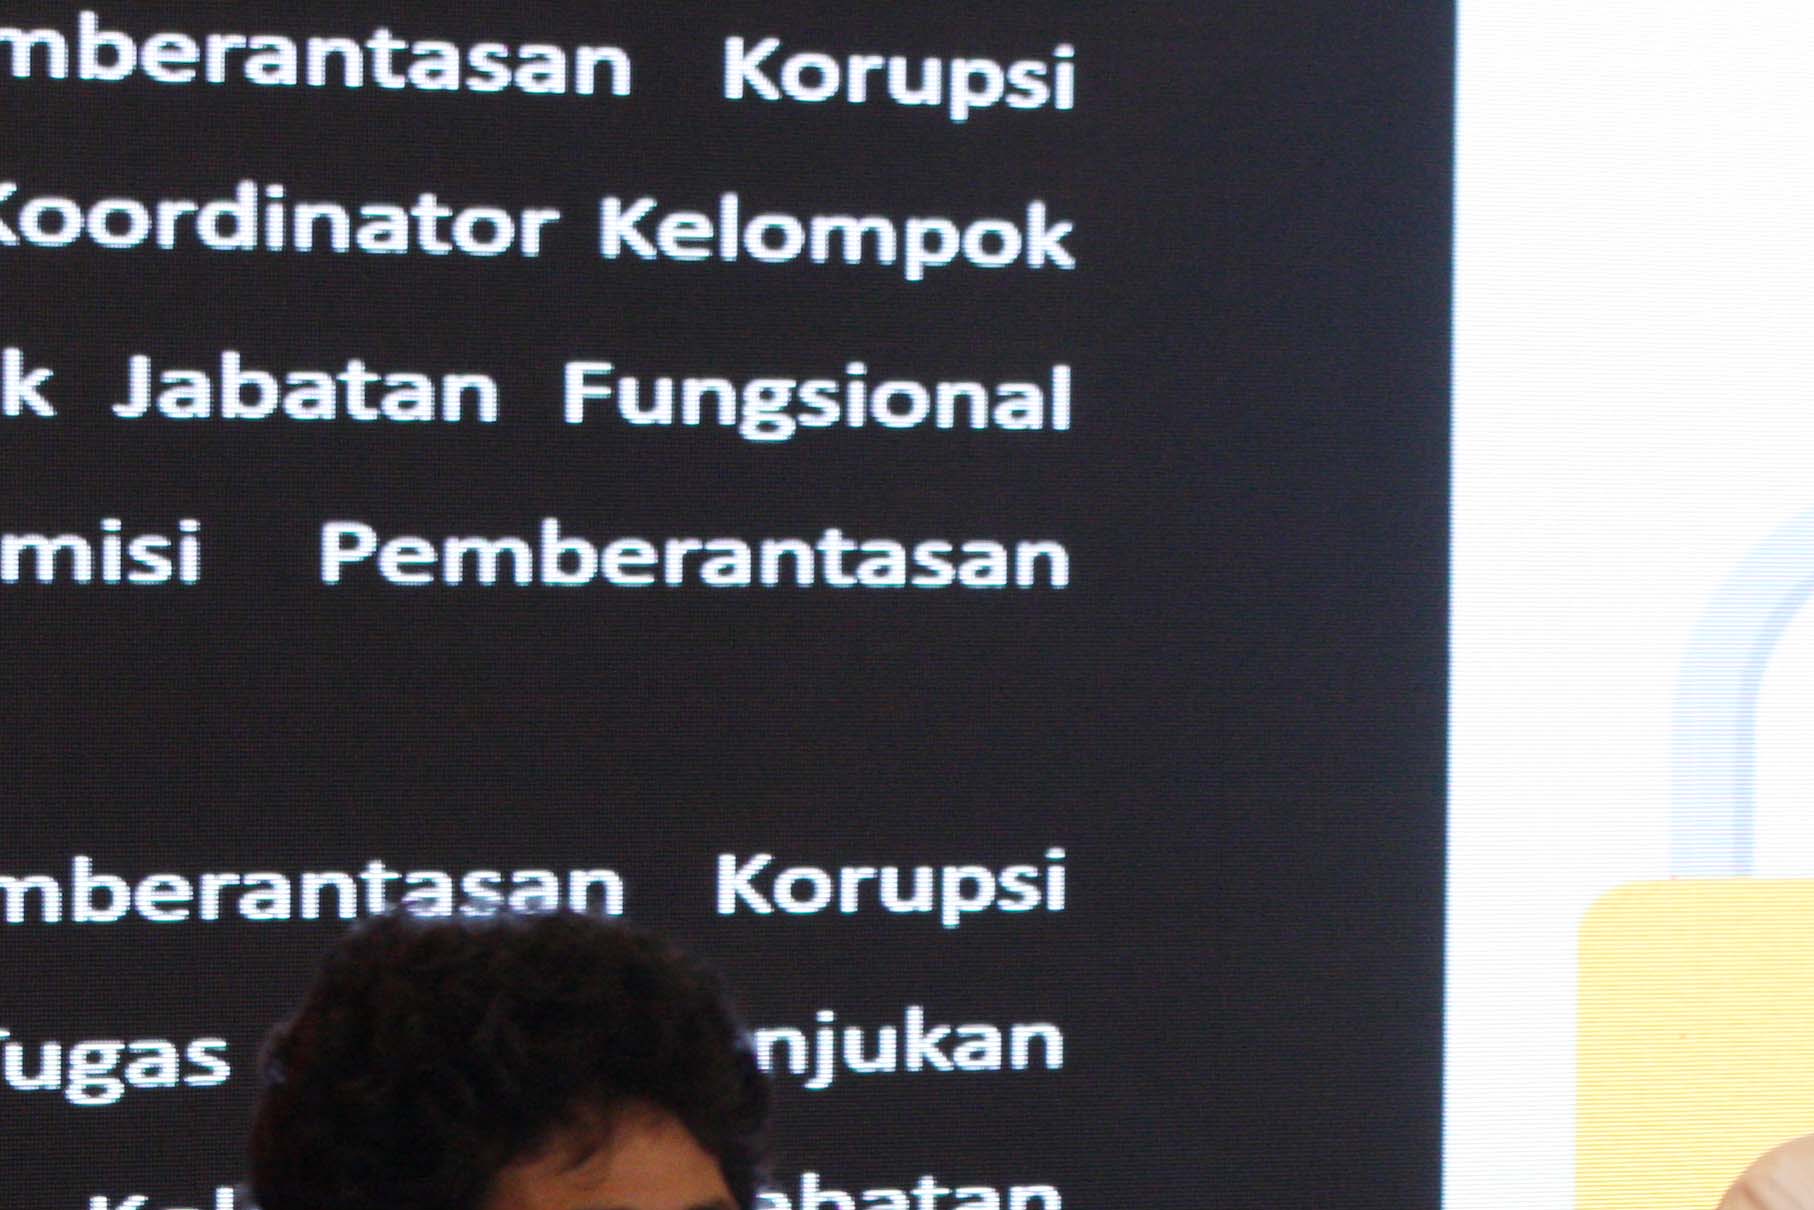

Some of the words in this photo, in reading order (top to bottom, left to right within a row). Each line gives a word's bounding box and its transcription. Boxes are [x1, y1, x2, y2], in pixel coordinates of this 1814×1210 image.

[0, 9, 632, 97] mberantasan
[724, 35, 1075, 123] Korupsi
[600, 191, 1076, 282] Kelompok
[111, 349, 499, 423] Jabatan
[564, 360, 1072, 443] Fungsional
[0, 517, 201, 585] misi
[321, 516, 1070, 589] Pemberantasan
[716, 846, 1066, 929] Korupsi
[0, 1027, 231, 1107] ugas
